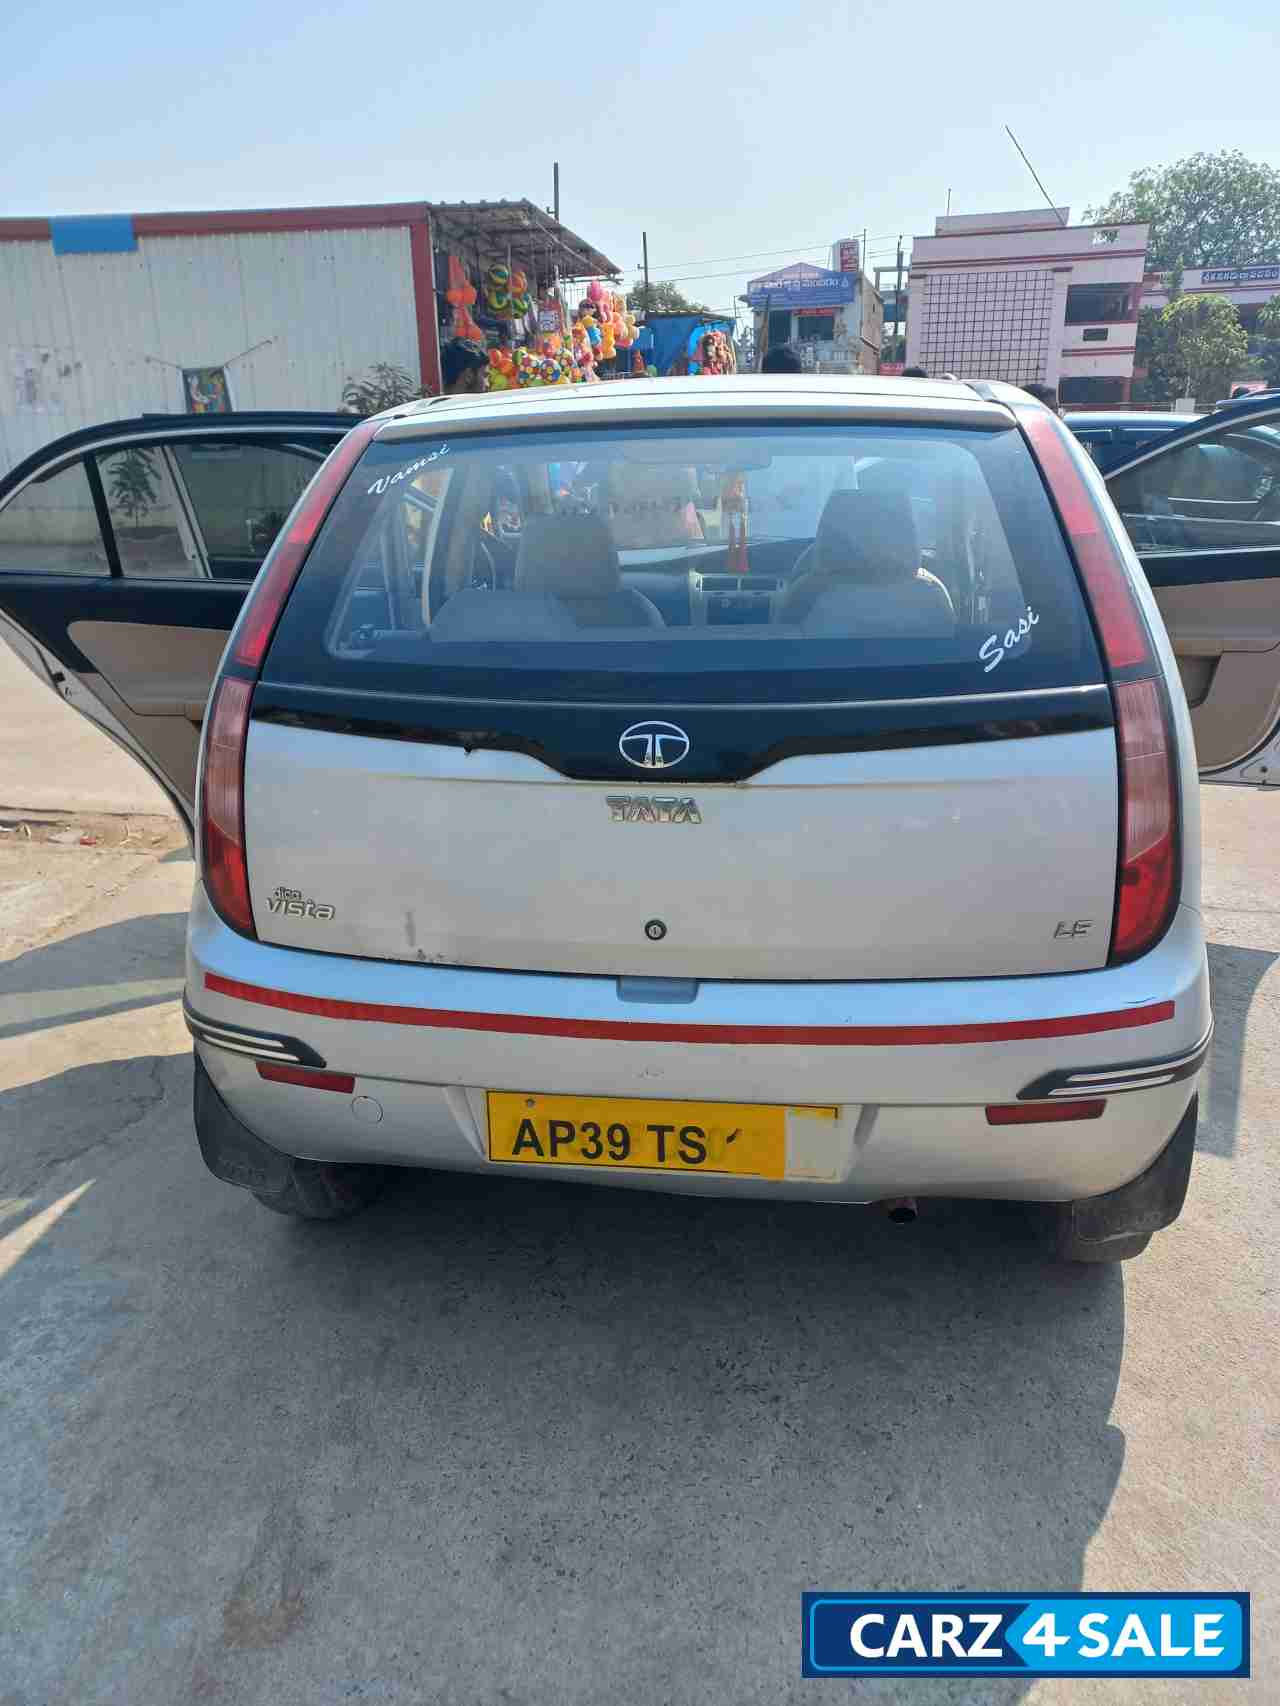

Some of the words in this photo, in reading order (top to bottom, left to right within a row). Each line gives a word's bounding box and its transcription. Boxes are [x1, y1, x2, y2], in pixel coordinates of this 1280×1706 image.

[367, 443, 450, 494] Vamsi
[979, 606, 1039, 673] Sasi
[606, 795, 702, 824] TATA
[511, 1118, 630, 1161] AP39
[646, 1124, 707, 1165] TS
